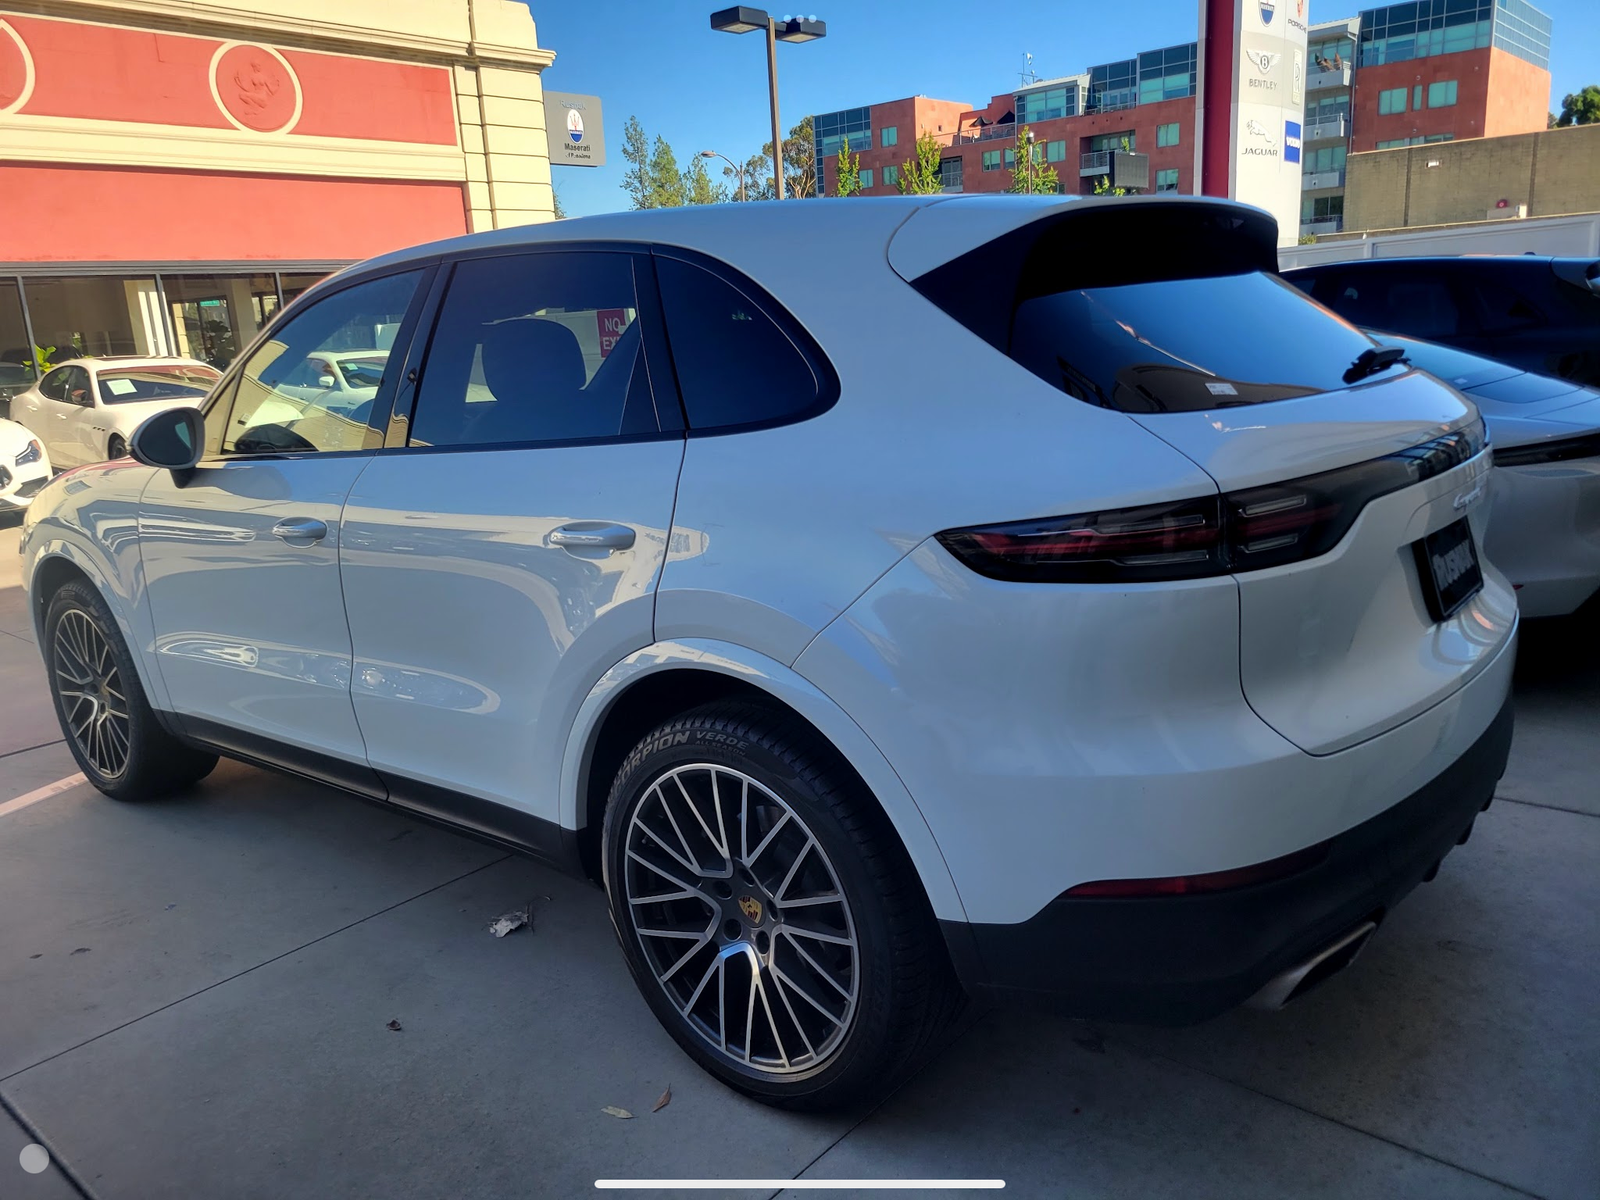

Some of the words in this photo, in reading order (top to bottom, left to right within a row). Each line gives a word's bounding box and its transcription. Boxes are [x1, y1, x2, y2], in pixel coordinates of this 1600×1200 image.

[1249, 78, 1278, 90] BENTLEY
[564, 143, 590, 151] Maserati
[1241, 147, 1278, 157] JAGUAR
[604, 317, 621, 332] NO
[602, 337, 620, 350] EX
[610, 730, 691, 802] CORPION
[696, 731, 750, 750] VERDE
